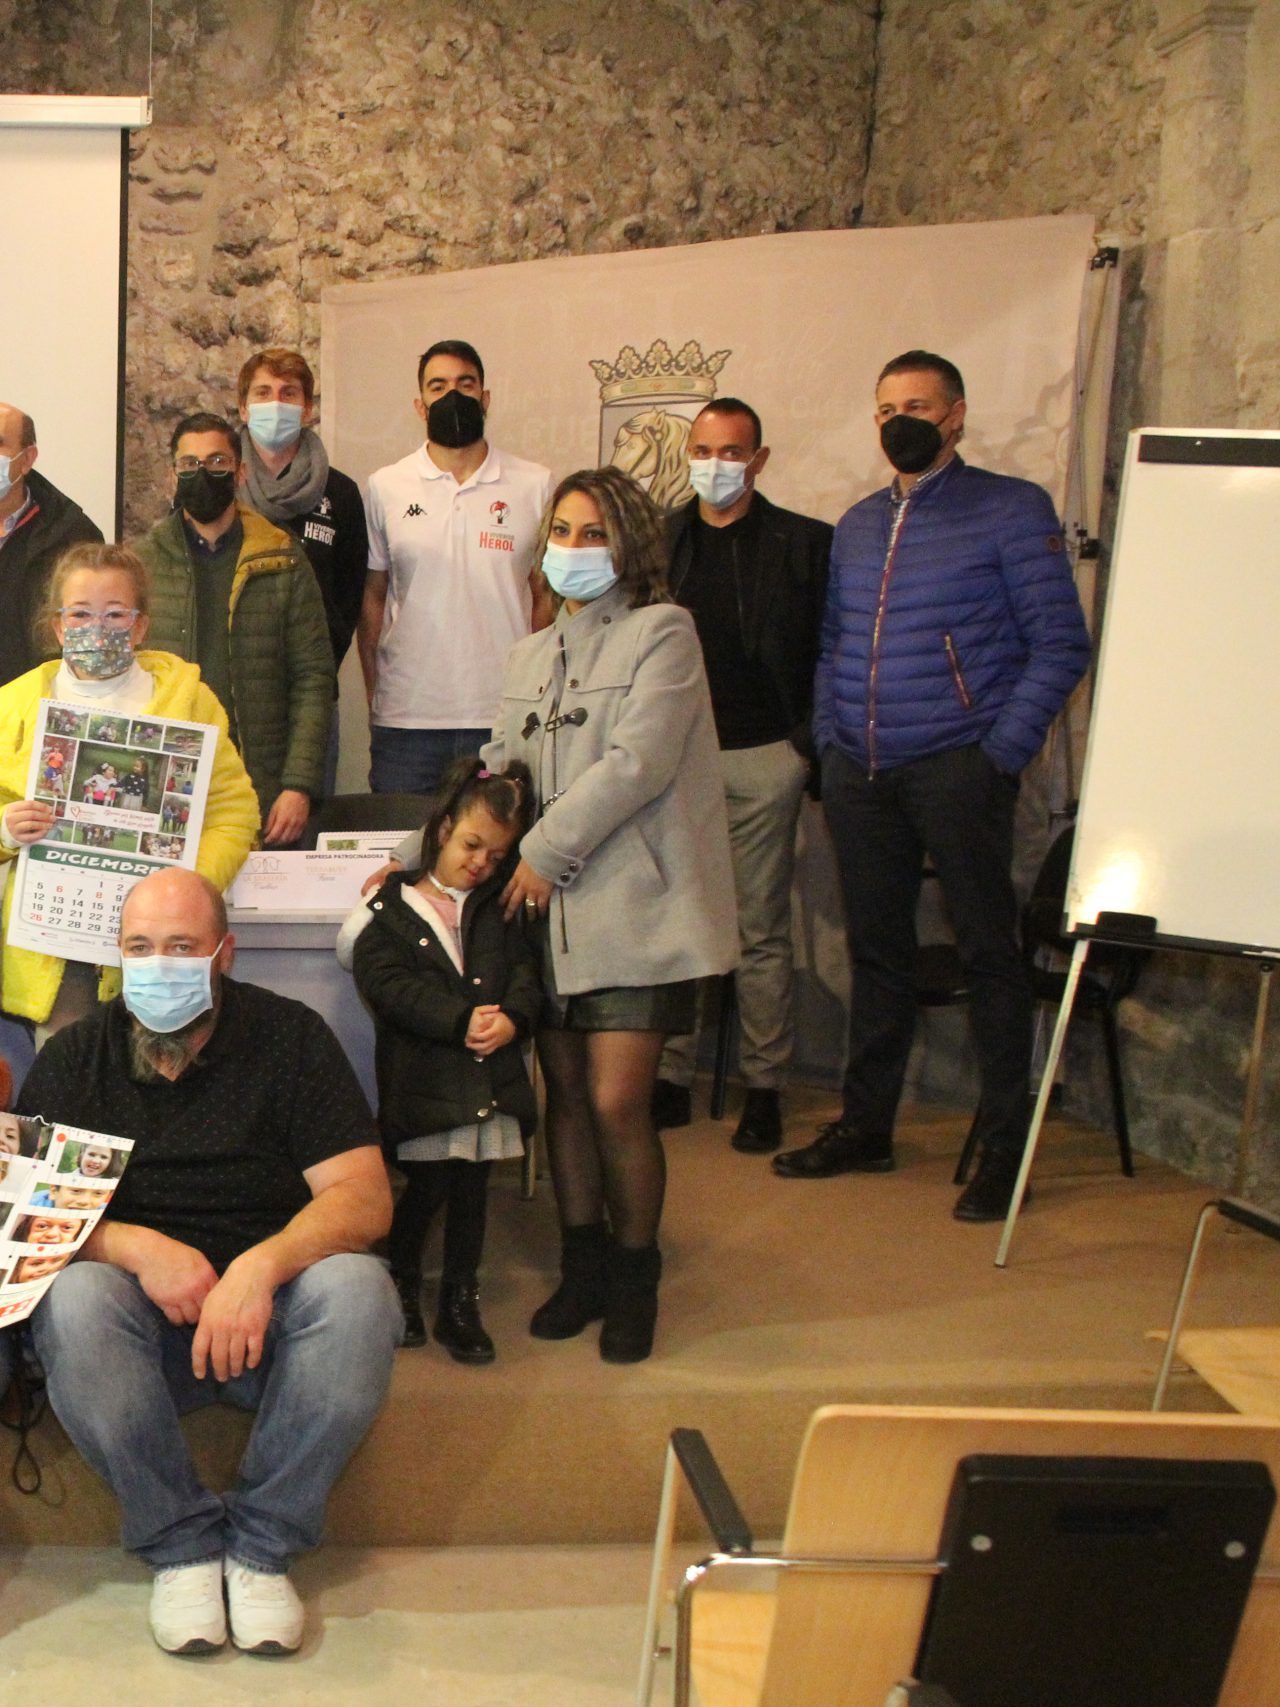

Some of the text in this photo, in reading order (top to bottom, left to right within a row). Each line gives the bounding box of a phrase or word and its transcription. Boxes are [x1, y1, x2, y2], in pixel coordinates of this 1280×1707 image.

[479, 530, 515, 552] HEROL
[37, 882, 122, 902] 5 6 7 8 9
[99, 881, 104, 889] 1
[33, 892, 45, 901] 12
[52, 895, 65, 904] 13
[72, 899, 84, 907] 14
[92, 902, 104, 911] 15
[32, 902, 44, 911] 19
[49, 906, 63, 915] 20
[69, 910, 83, 918] 21
[89, 913, 103, 921] 22
[30, 912, 121, 935] 26 27 28 29 30
